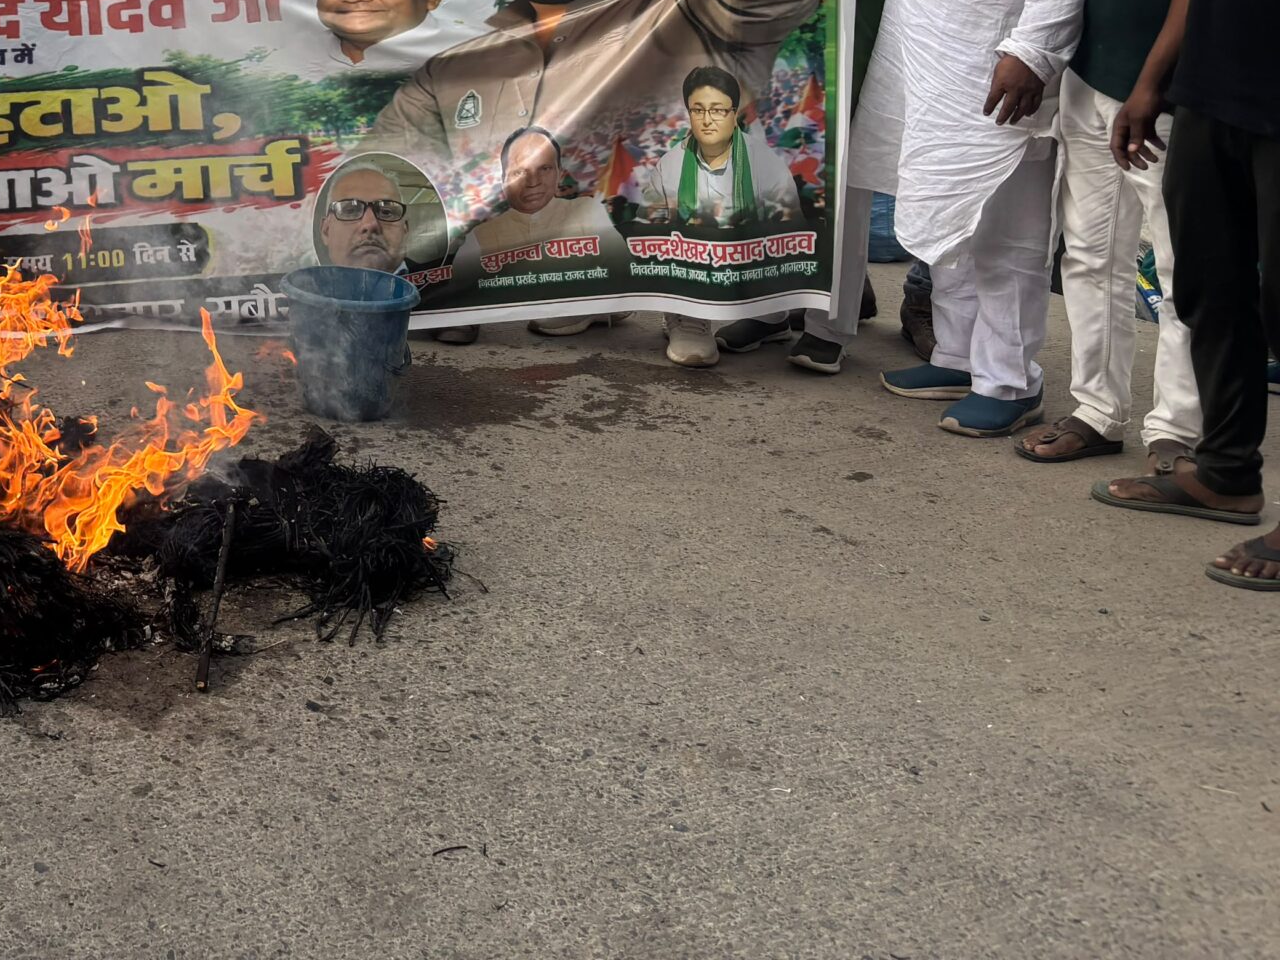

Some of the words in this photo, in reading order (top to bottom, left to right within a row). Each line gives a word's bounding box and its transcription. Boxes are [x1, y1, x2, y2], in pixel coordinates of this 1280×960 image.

[10, 42, 38, 66] में
[126, 140, 302, 200] मार्च
[62, 250, 125, 270] 11:00
[132, 242, 171, 265] दिन
[177, 240, 197, 262] से
[481, 244, 542, 272] सुमन्त
[545, 237, 599, 256] यादव
[629, 233, 709, 262] चन्द्रशेखर
[710, 240, 763, 266] प्रसाद
[766, 232, 816, 255] यादव
